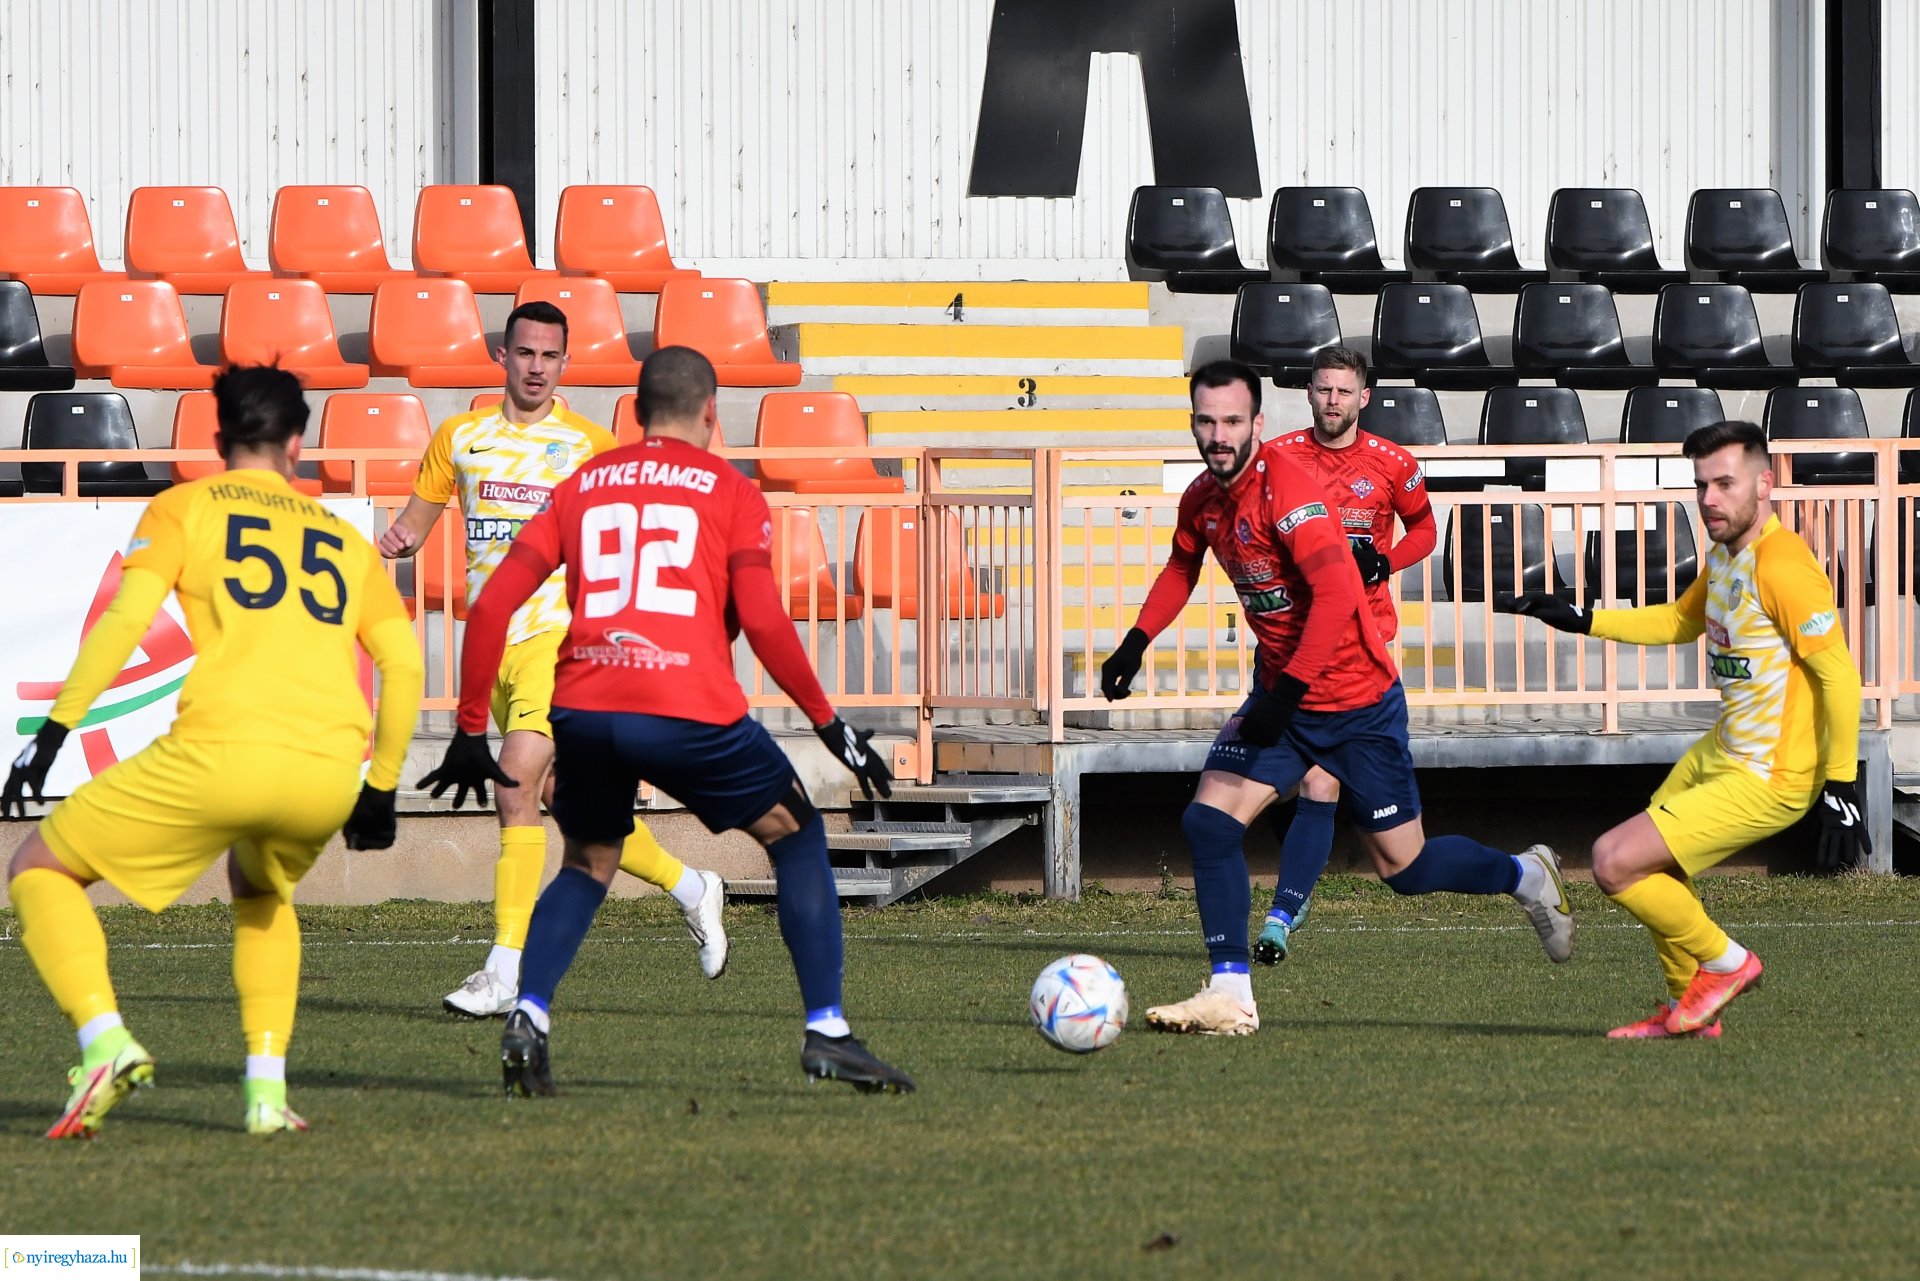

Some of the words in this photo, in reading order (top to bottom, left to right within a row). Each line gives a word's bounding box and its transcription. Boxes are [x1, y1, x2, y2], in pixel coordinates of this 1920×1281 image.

[945, 293, 964, 322] 4
[1018, 378, 1037, 407] 3
[578, 461, 640, 494] MYKE
[639, 460, 718, 494] RAMOS
[224, 513, 347, 625] 55
[581, 502, 699, 619] 92
[1372, 804, 1399, 820] JAKO
[1283, 887, 1305, 900] JAKO
[1205, 934, 1226, 943] AKO
